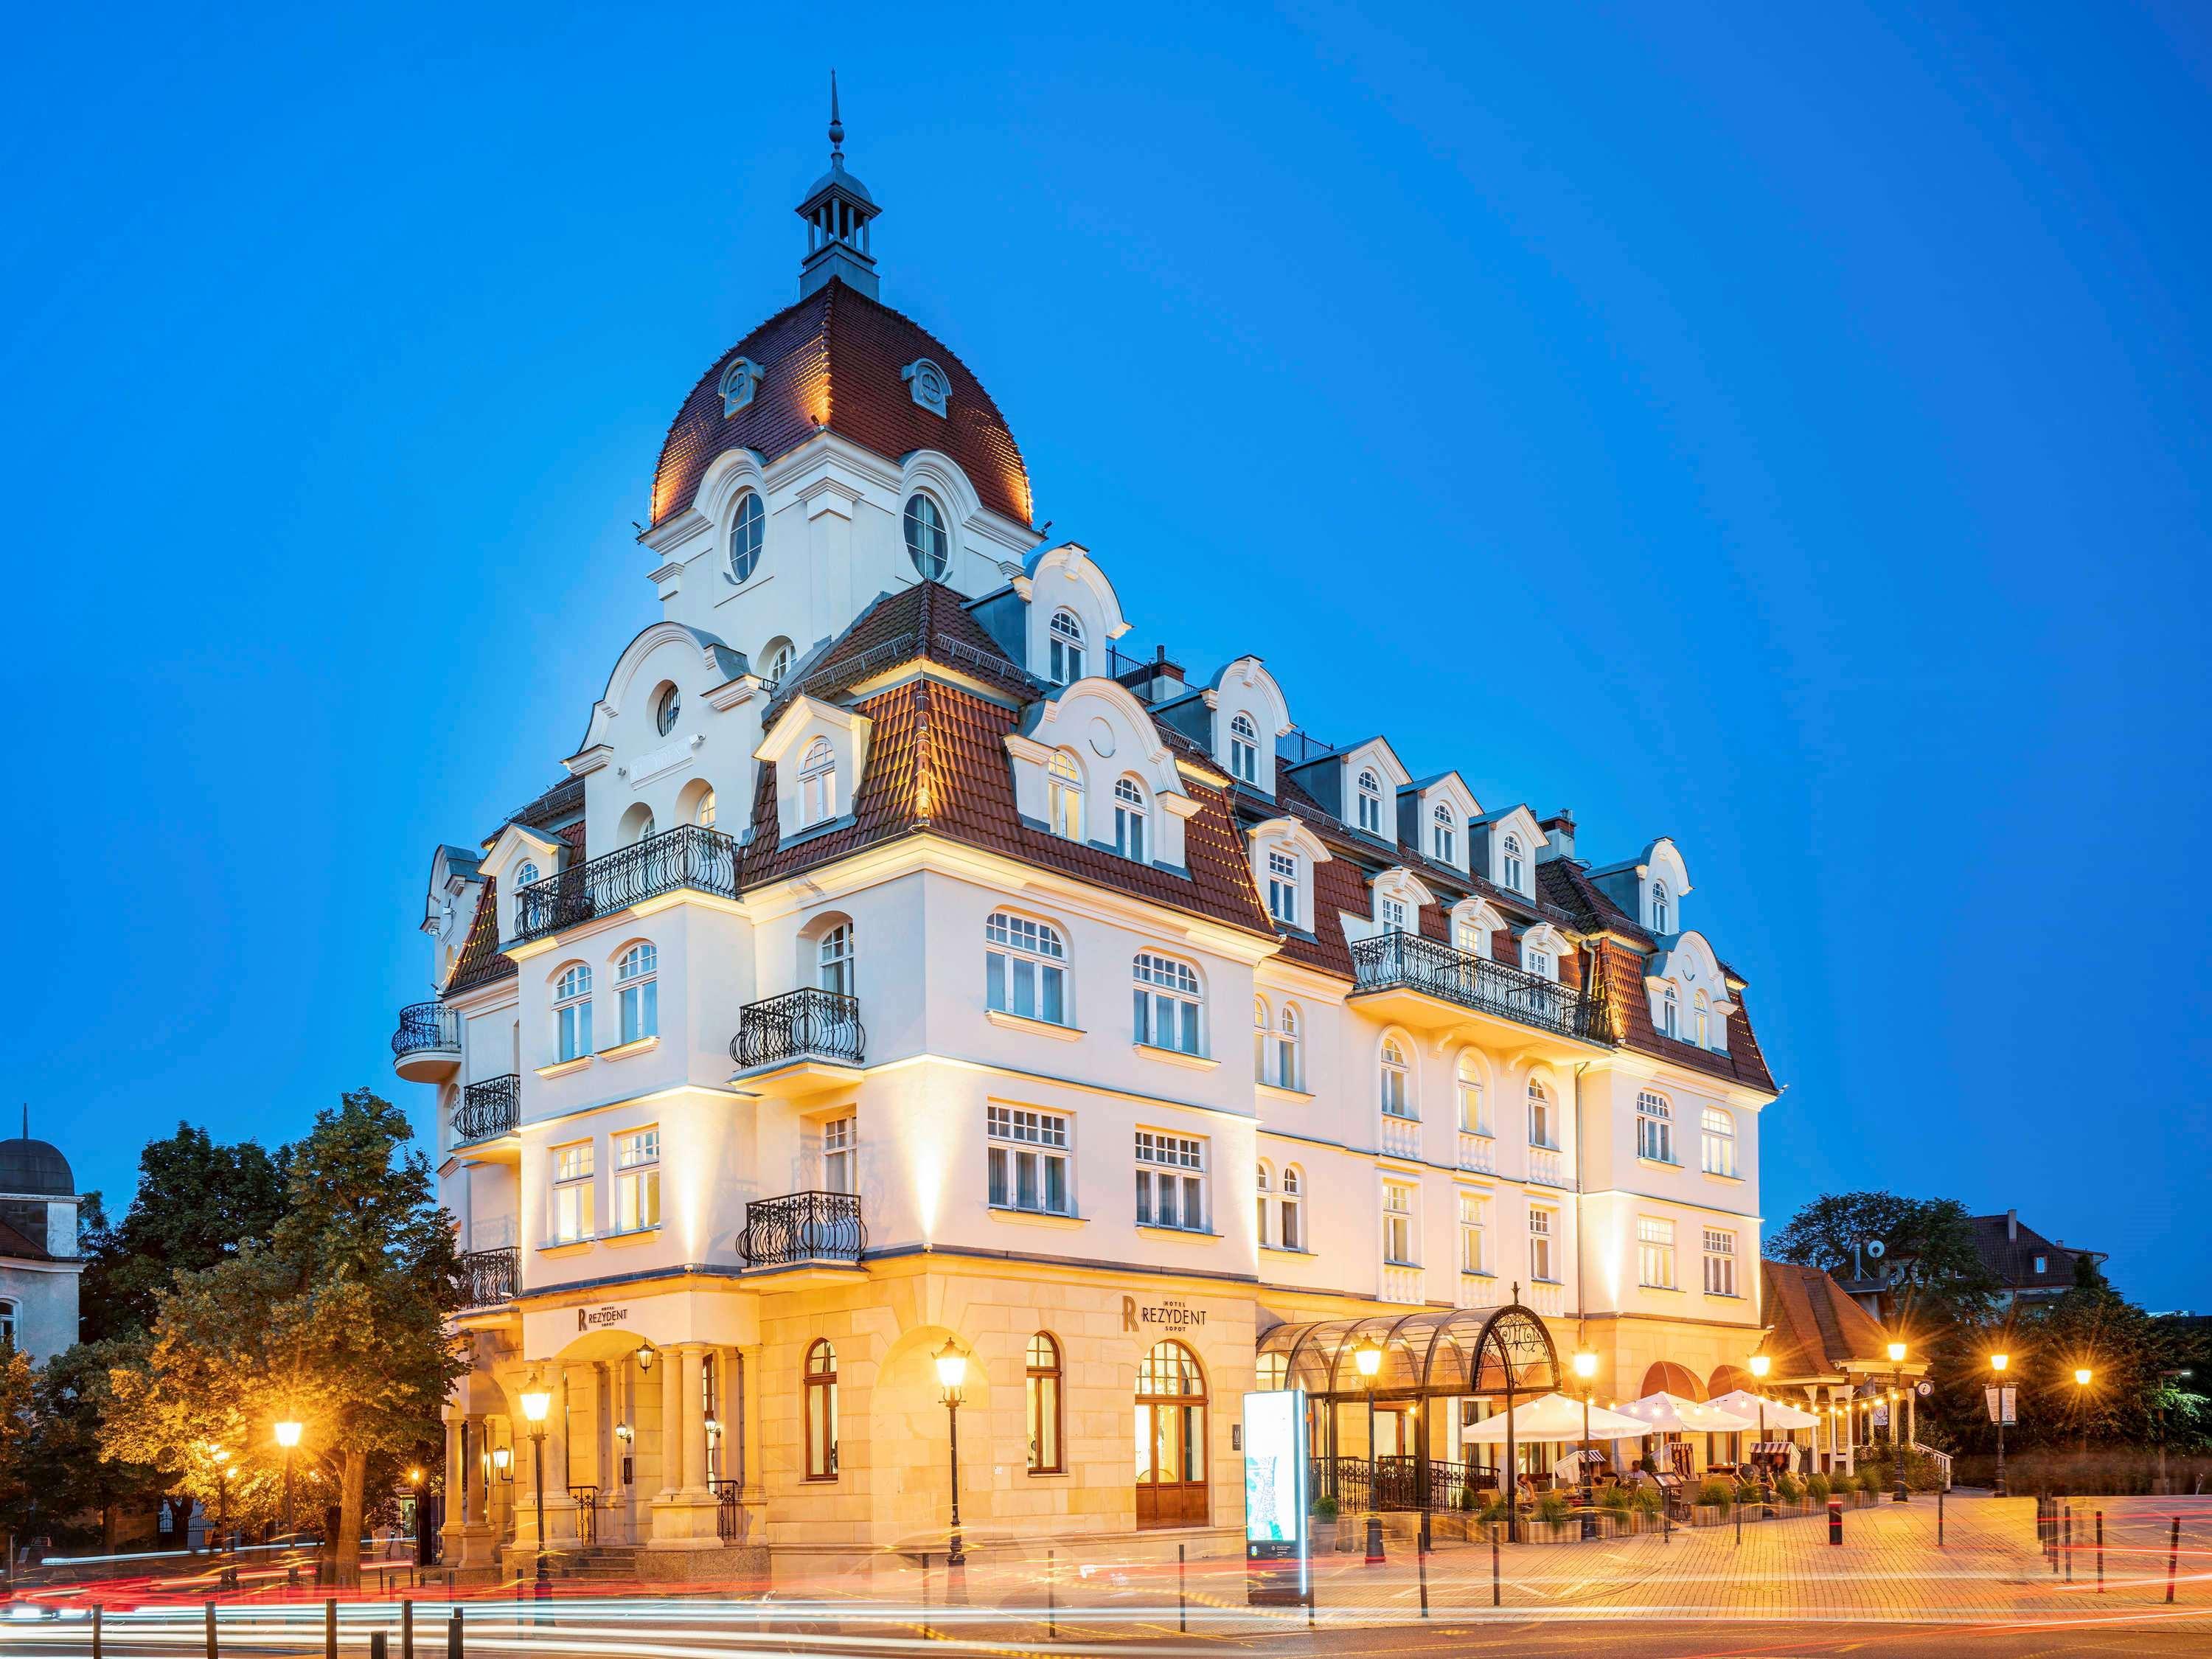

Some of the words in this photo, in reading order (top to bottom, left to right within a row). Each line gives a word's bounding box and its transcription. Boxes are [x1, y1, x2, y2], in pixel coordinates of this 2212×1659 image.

[578, 1308, 588, 1332] R
[588, 1309, 627, 1324] REZYDENT
[1122, 1295, 1139, 1332] R
[1142, 1307, 1206, 1326] REZYDENT
